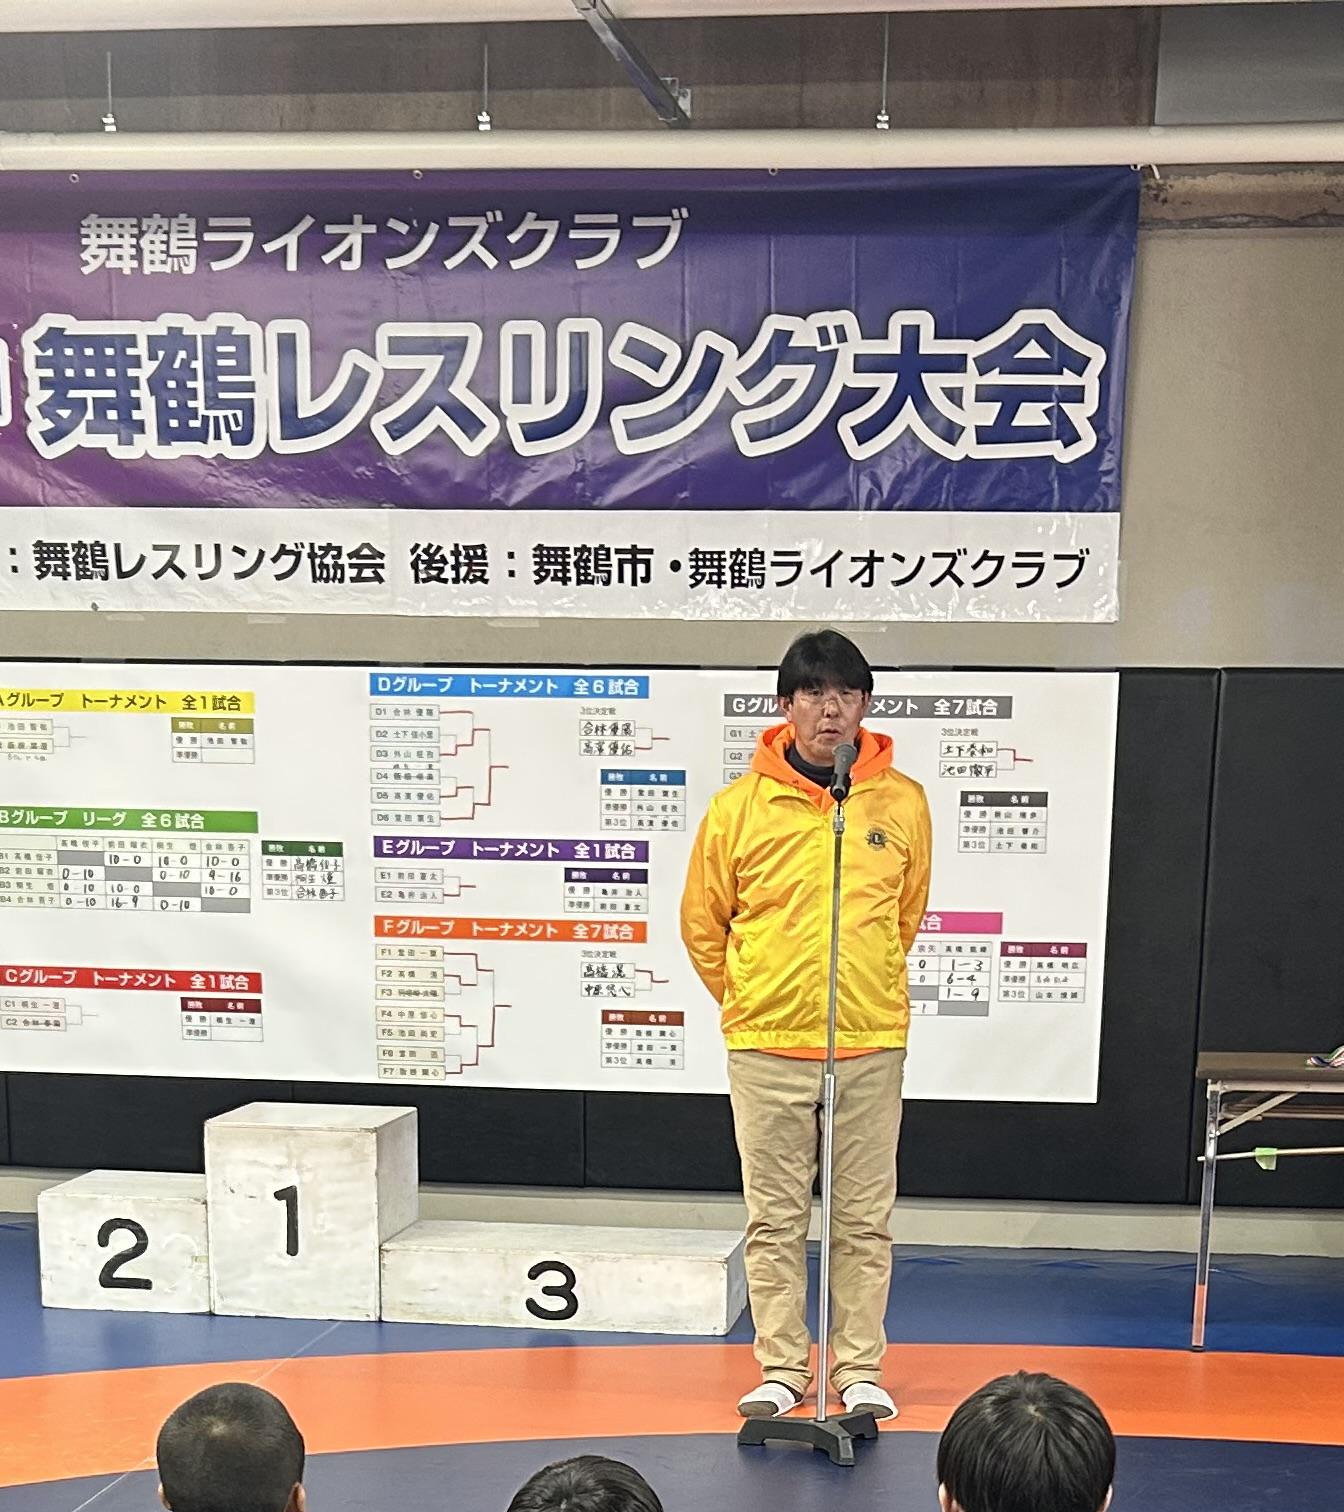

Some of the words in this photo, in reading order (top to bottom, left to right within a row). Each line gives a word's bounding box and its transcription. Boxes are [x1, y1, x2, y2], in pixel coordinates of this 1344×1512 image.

[80, 207, 689, 277] 舞鶴ライオンズクラブ
[24, 308, 1106, 463] 舞鶴レスリング大会
[378, 677, 453, 692] Dグループ
[471, 678, 558, 694] トーナメント
[574, 678, 639, 695] 全6試合
[83, 694, 166, 709] トーナメント
[182, 695, 241, 711] 全1試合
[733, 697, 778, 713] Gグル
[872, 699, 918, 715] メント
[934, 699, 998, 715] 全7試合
[83, 812, 127, 826] リーグ
[141, 812, 204, 829] 全6試合
[383, 839, 455, 855] Eグループ
[473, 841, 559, 857] トーナメント
[574, 842, 636, 859] 全1試合
[384, 919, 455, 935] Fグループ
[472, 922, 558, 938] トーナメント
[573, 924, 634, 940] 全7試合
[6, 969, 77, 984] Cグループ
[94, 971, 176, 987] トーナメント
[190, 974, 249, 990] 全1試合
[273, 1185, 298, 1256] 1
[97, 1218, 153, 1290] 2
[525, 1260, 579, 1320] 3
